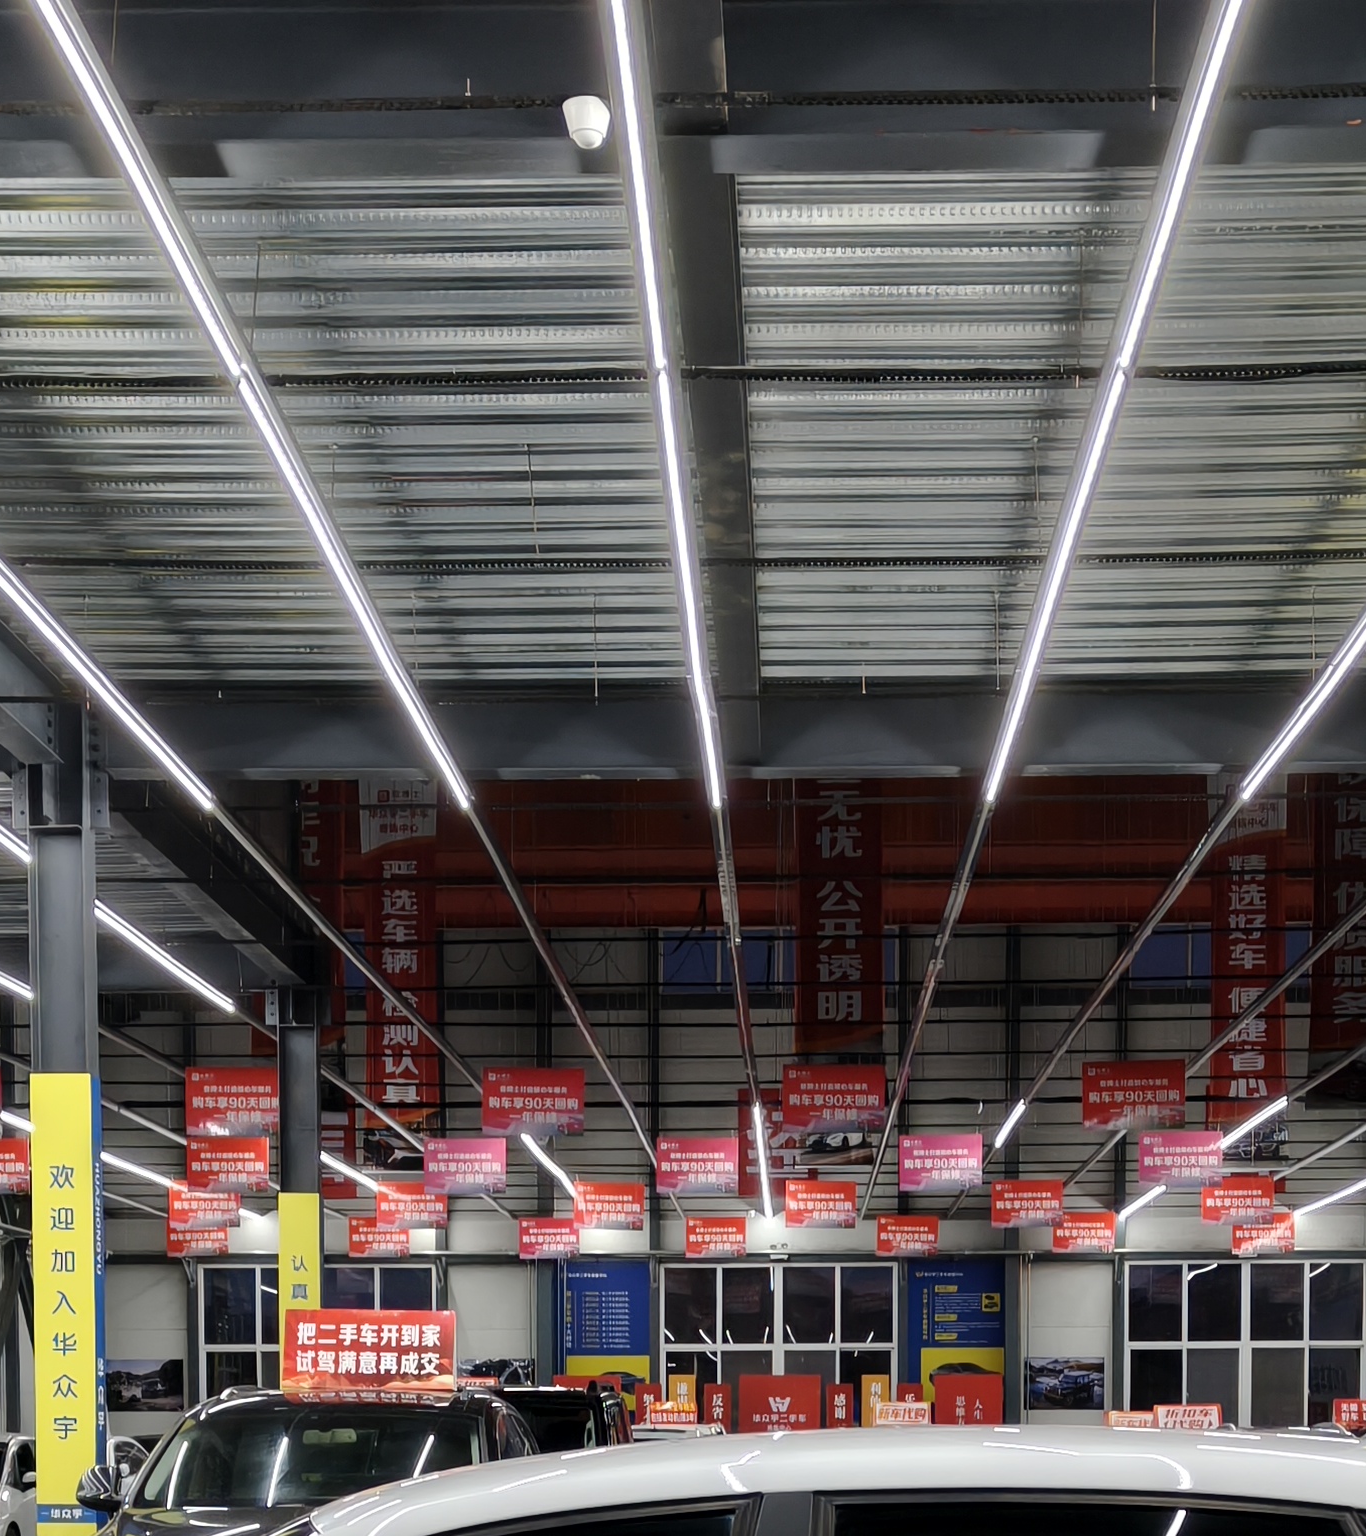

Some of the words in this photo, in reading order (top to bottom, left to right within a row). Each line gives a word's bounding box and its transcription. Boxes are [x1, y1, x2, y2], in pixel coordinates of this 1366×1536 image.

[815, 779, 863, 859] 无忧
[381, 860, 418, 974] 严选车辆
[1228, 854, 1267, 969] 精选好车
[381, 990, 421, 1104] 检测认真
[1228, 986, 1268, 1099] 便捷省心
[489, 1097, 578, 1109] 购车享90天回购
[789, 1094, 879, 1106] 购车享90天回购
[1089, 1090, 1179, 1102] 购车享90天回购
[510, 1112, 557, 1123] 一年保修
[810, 1108, 857, 1120] 一年保修
[191, 1162, 264, 1171] 购车享90天回购
[661, 1162, 734, 1172] 购车享90天回购
[904, 1158, 977, 1169] 购车享90天回购
[1144, 1156, 1218, 1167] 购车享90天回购
[94, 1162, 103, 1276] HUAZHONGYU
[291, 1254, 309, 1301] 认真
[49, 1163, 78, 1441] 欢迎加入华众宇
[297, 1322, 441, 1348] 把二手车开到家
[296, 1351, 440, 1376] 试驾满意再成交
[50, 1507, 83, 1519] 华众宇
